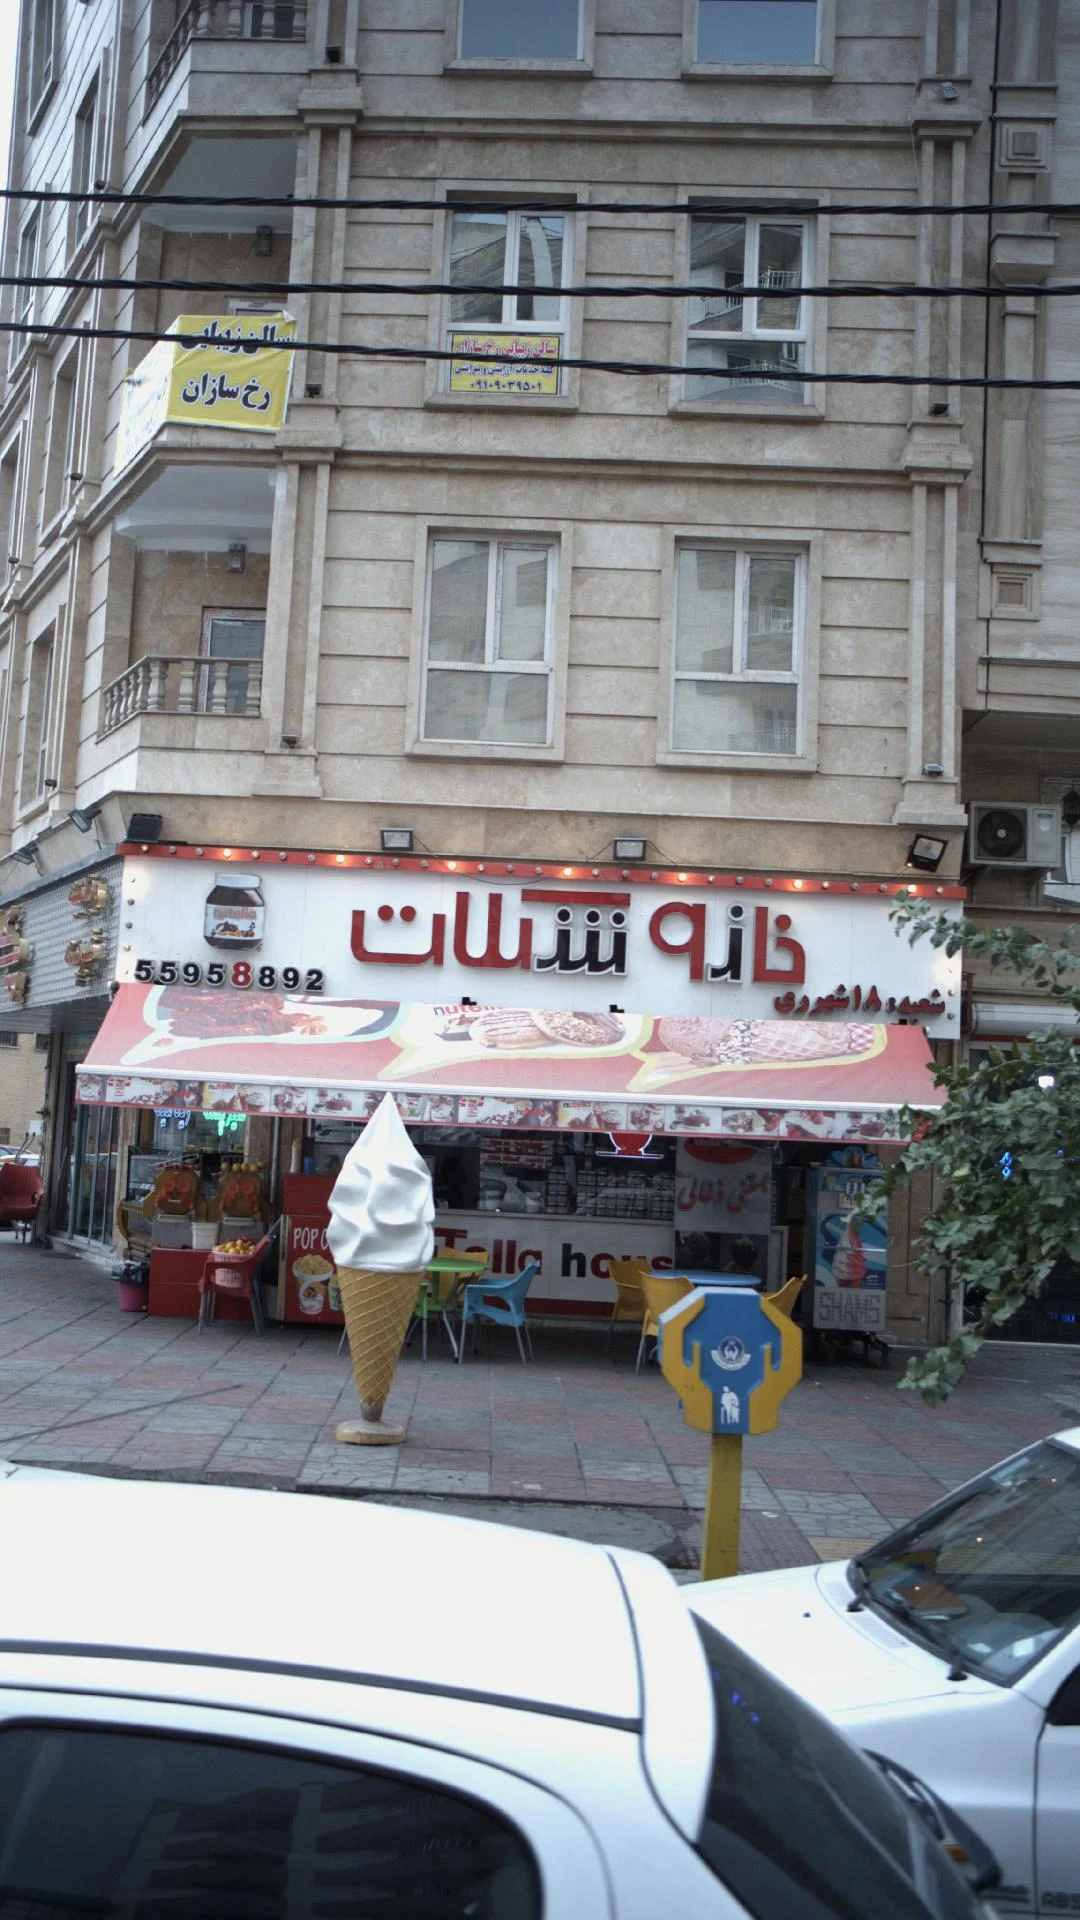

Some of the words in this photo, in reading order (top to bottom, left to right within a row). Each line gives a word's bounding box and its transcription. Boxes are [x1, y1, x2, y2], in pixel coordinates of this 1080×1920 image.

[180, 371, 240, 407] سازان
[242, 376, 272, 412] رخ
[350, 889, 630, 975] شکلات
[134, 958, 326, 993] 55958892
[293, 1226, 319, 1249] POP
[818, 1291, 881, 1325] SHAMS
